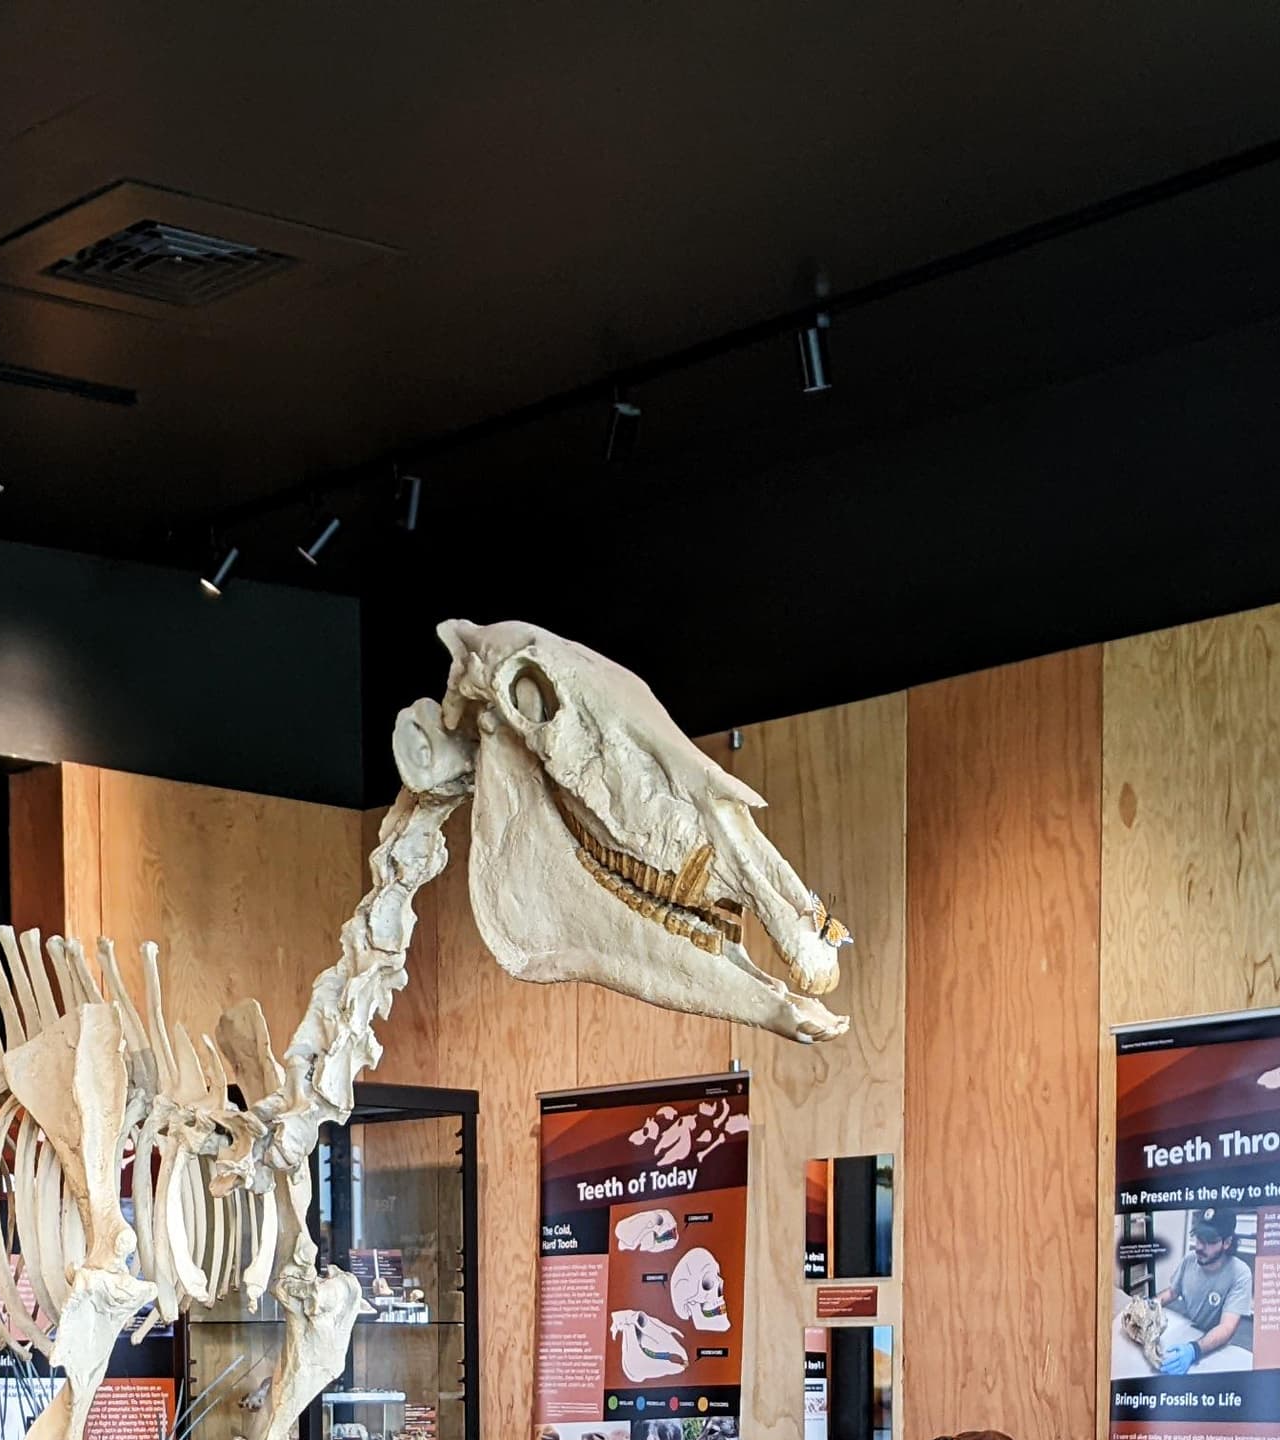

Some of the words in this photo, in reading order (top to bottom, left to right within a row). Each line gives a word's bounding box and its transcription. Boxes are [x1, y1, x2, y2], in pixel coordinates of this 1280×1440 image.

[1144, 1136, 1211, 1168] Teeth
[577, 1176, 623, 1201] Teeth
[628, 1175, 647, 1194] of
[650, 1168, 698, 1193] Today
[1121, 1192, 1137, 1206] The
[1141, 1189, 1182, 1204] Present
[1185, 1189, 1193, 1201] is
[1198, 1186, 1218, 1200] the
[1222, 1185, 1245, 1202] Key
[1248, 1185, 1261, 1197] to
[543, 1225, 553, 1235] The
[554, 1224, 572, 1235] Cold,
[543, 1240, 556, 1250] Hard
[558, 1238, 577, 1249] Tooth
[1115, 1393, 1157, 1409] Bringing
[1160, 1393, 1198, 1406] Fossils
[1202, 1394, 1215, 1406] to
[1219, 1393, 1241, 1407] Life
